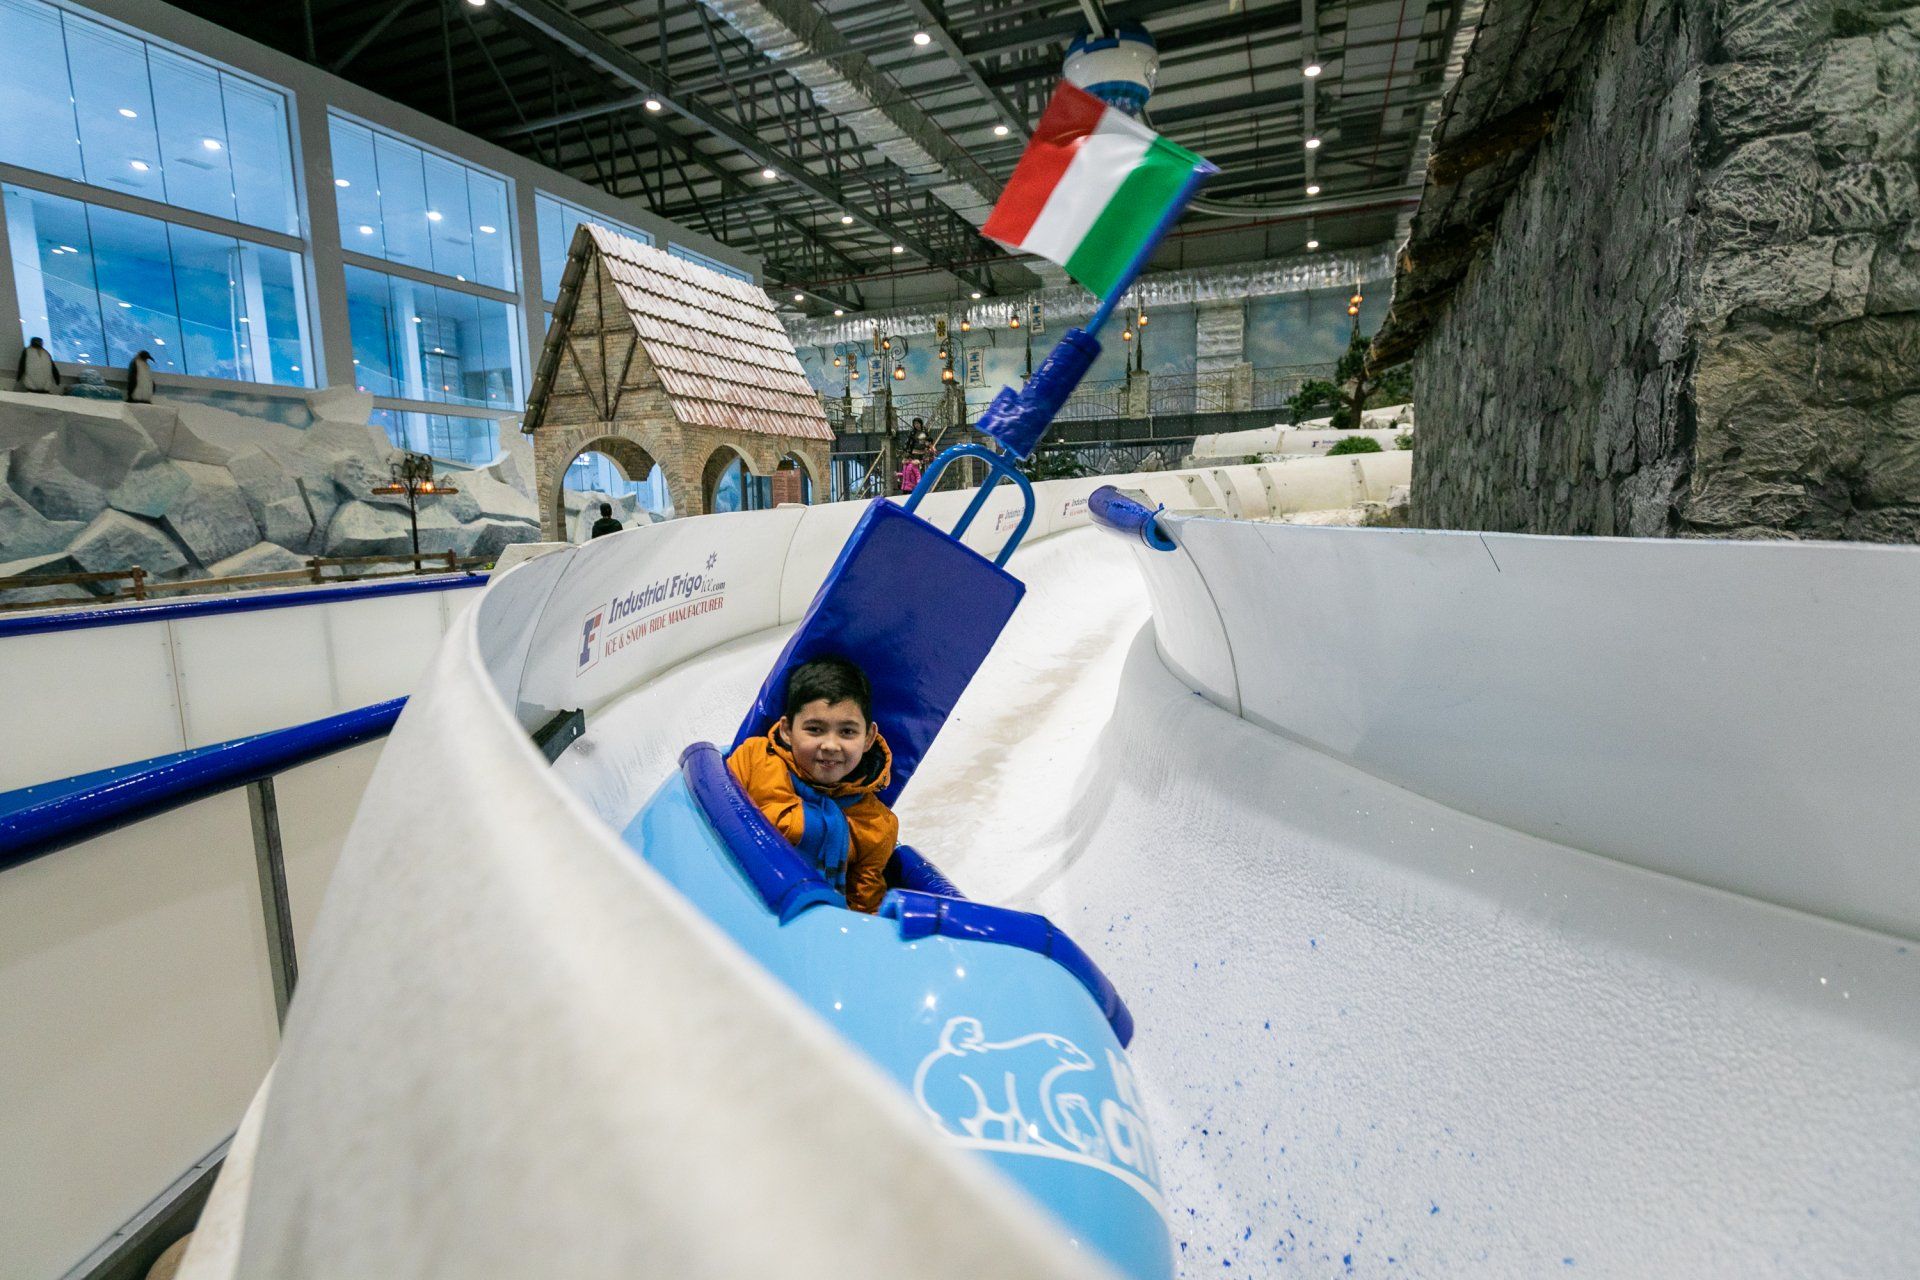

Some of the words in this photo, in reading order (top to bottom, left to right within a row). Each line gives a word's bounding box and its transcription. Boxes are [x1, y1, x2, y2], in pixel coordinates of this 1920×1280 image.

[608, 578, 670, 624] Industrial
[669, 572, 703, 598] Frigo
[605, 637, 618, 657] ICE
[618, 633, 625, 649] &
[626, 622, 647, 645] SNOW
[649, 613, 667, 633] RIDE
[668, 596, 724, 625] MANUFACTURER
